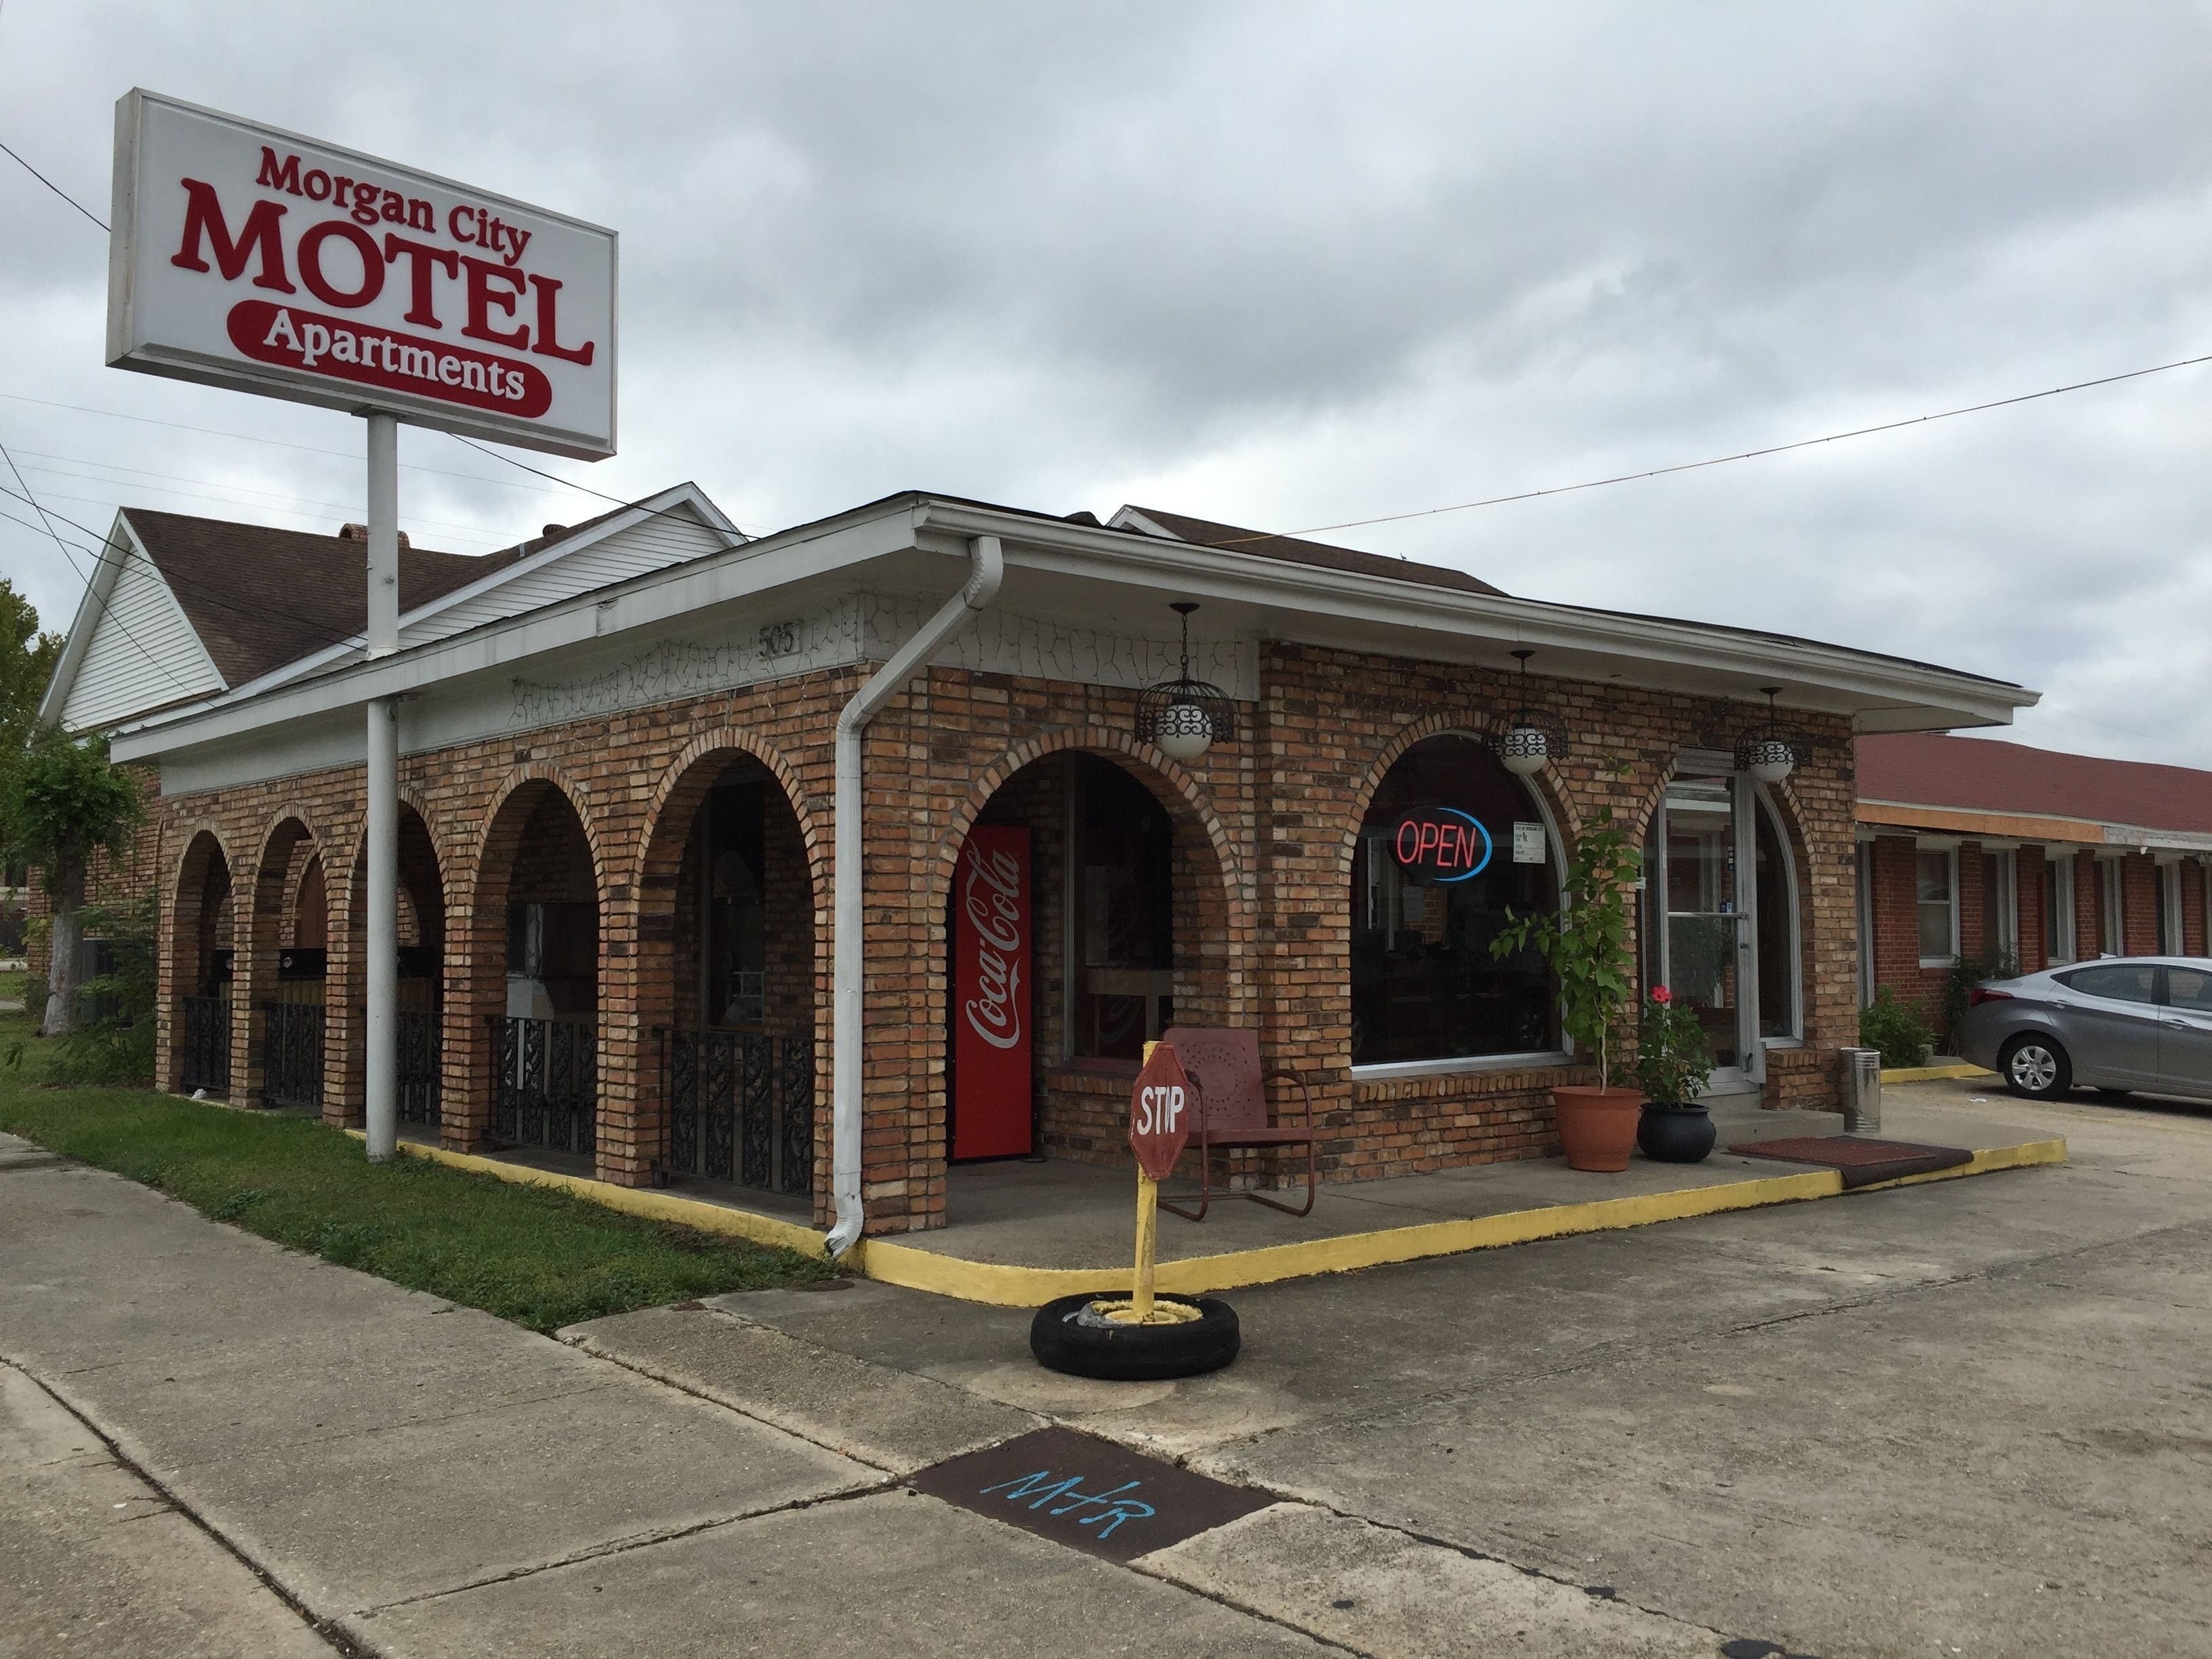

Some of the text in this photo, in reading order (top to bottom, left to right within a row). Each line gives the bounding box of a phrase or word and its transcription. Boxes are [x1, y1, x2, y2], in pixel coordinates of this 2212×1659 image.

[255, 145, 532, 266] Morgan City
[171, 177, 595, 366] MOTEL
[262, 309, 525, 401] Apartments
[1396, 819, 1477, 868] OPEN
